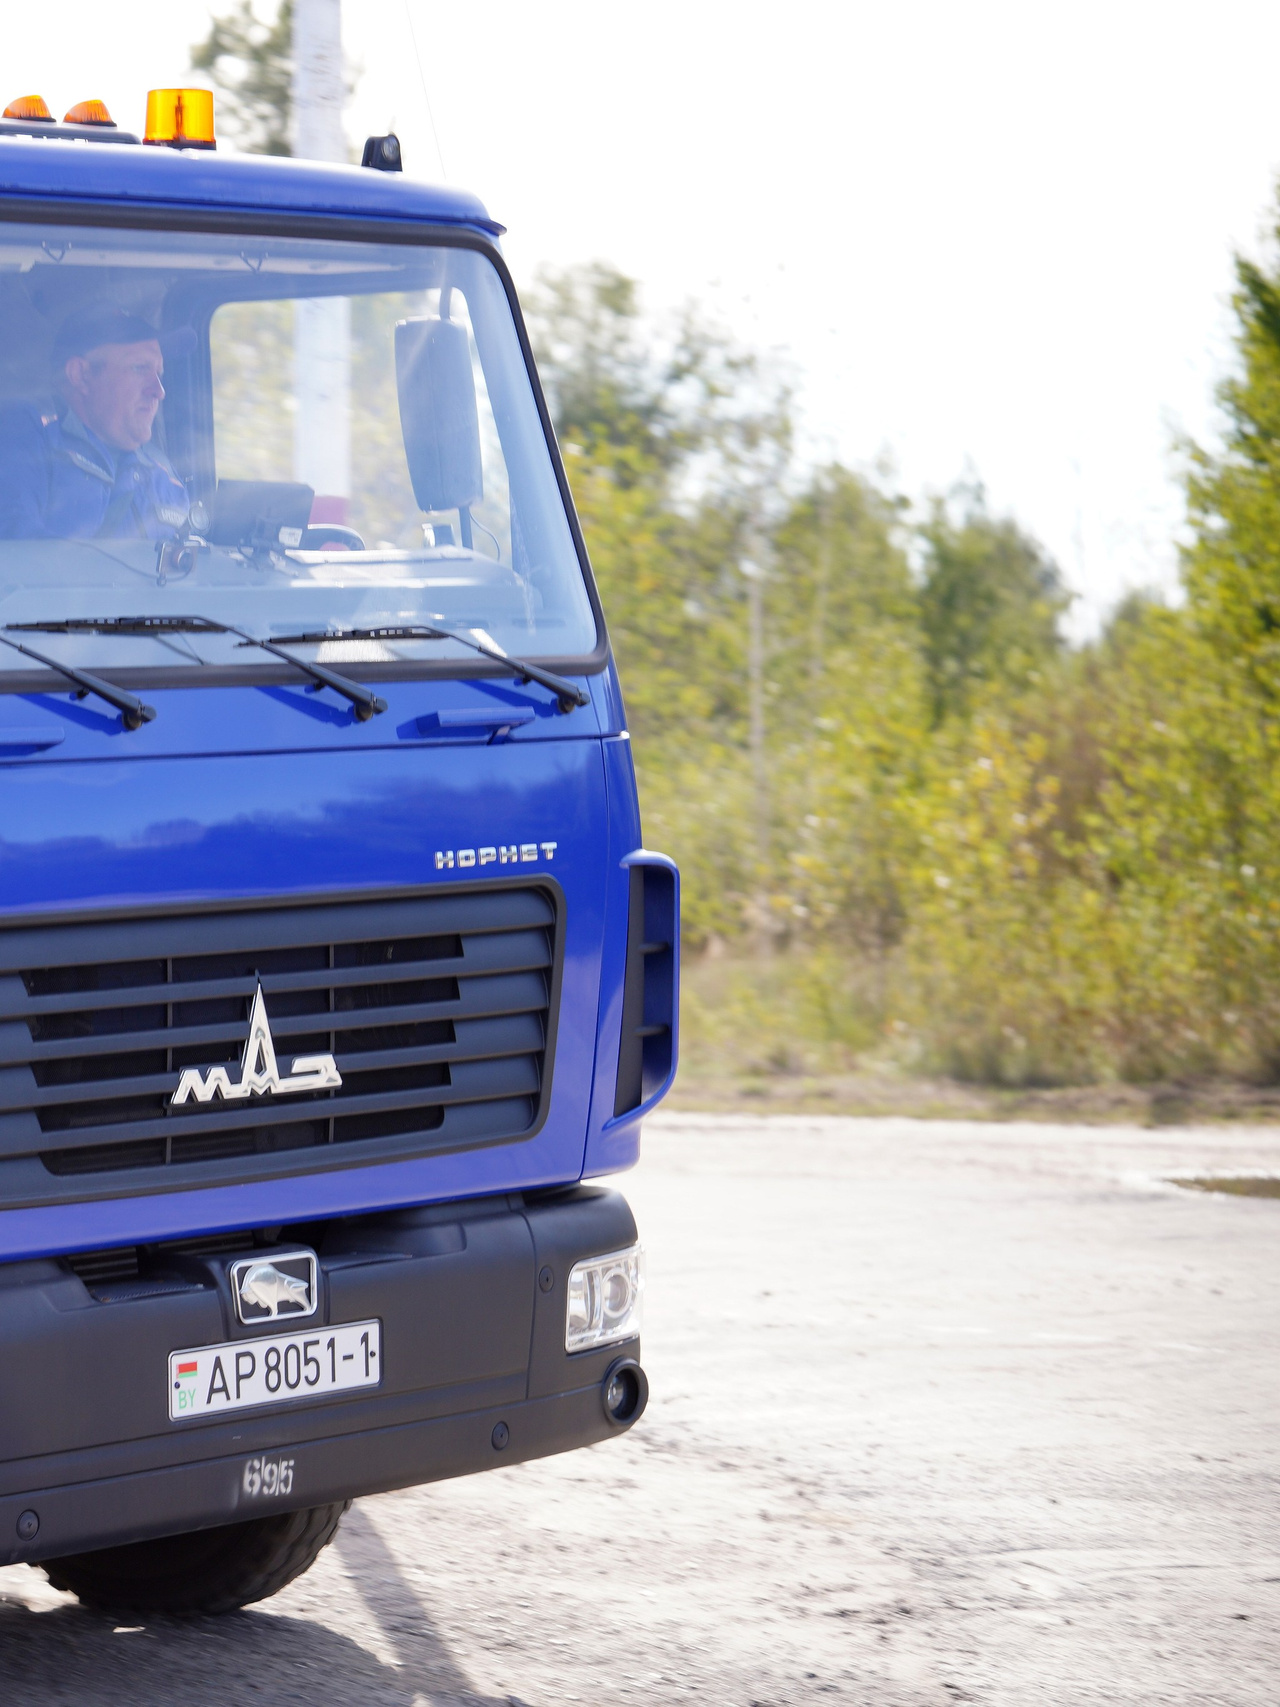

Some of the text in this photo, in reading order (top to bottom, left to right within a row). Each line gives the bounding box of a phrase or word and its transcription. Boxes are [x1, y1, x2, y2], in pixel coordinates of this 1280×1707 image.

[264, 1331, 371, 1394] 8051-1
[177, 1388, 198, 1410] BY
[242, 1456, 296, 1496] 695
